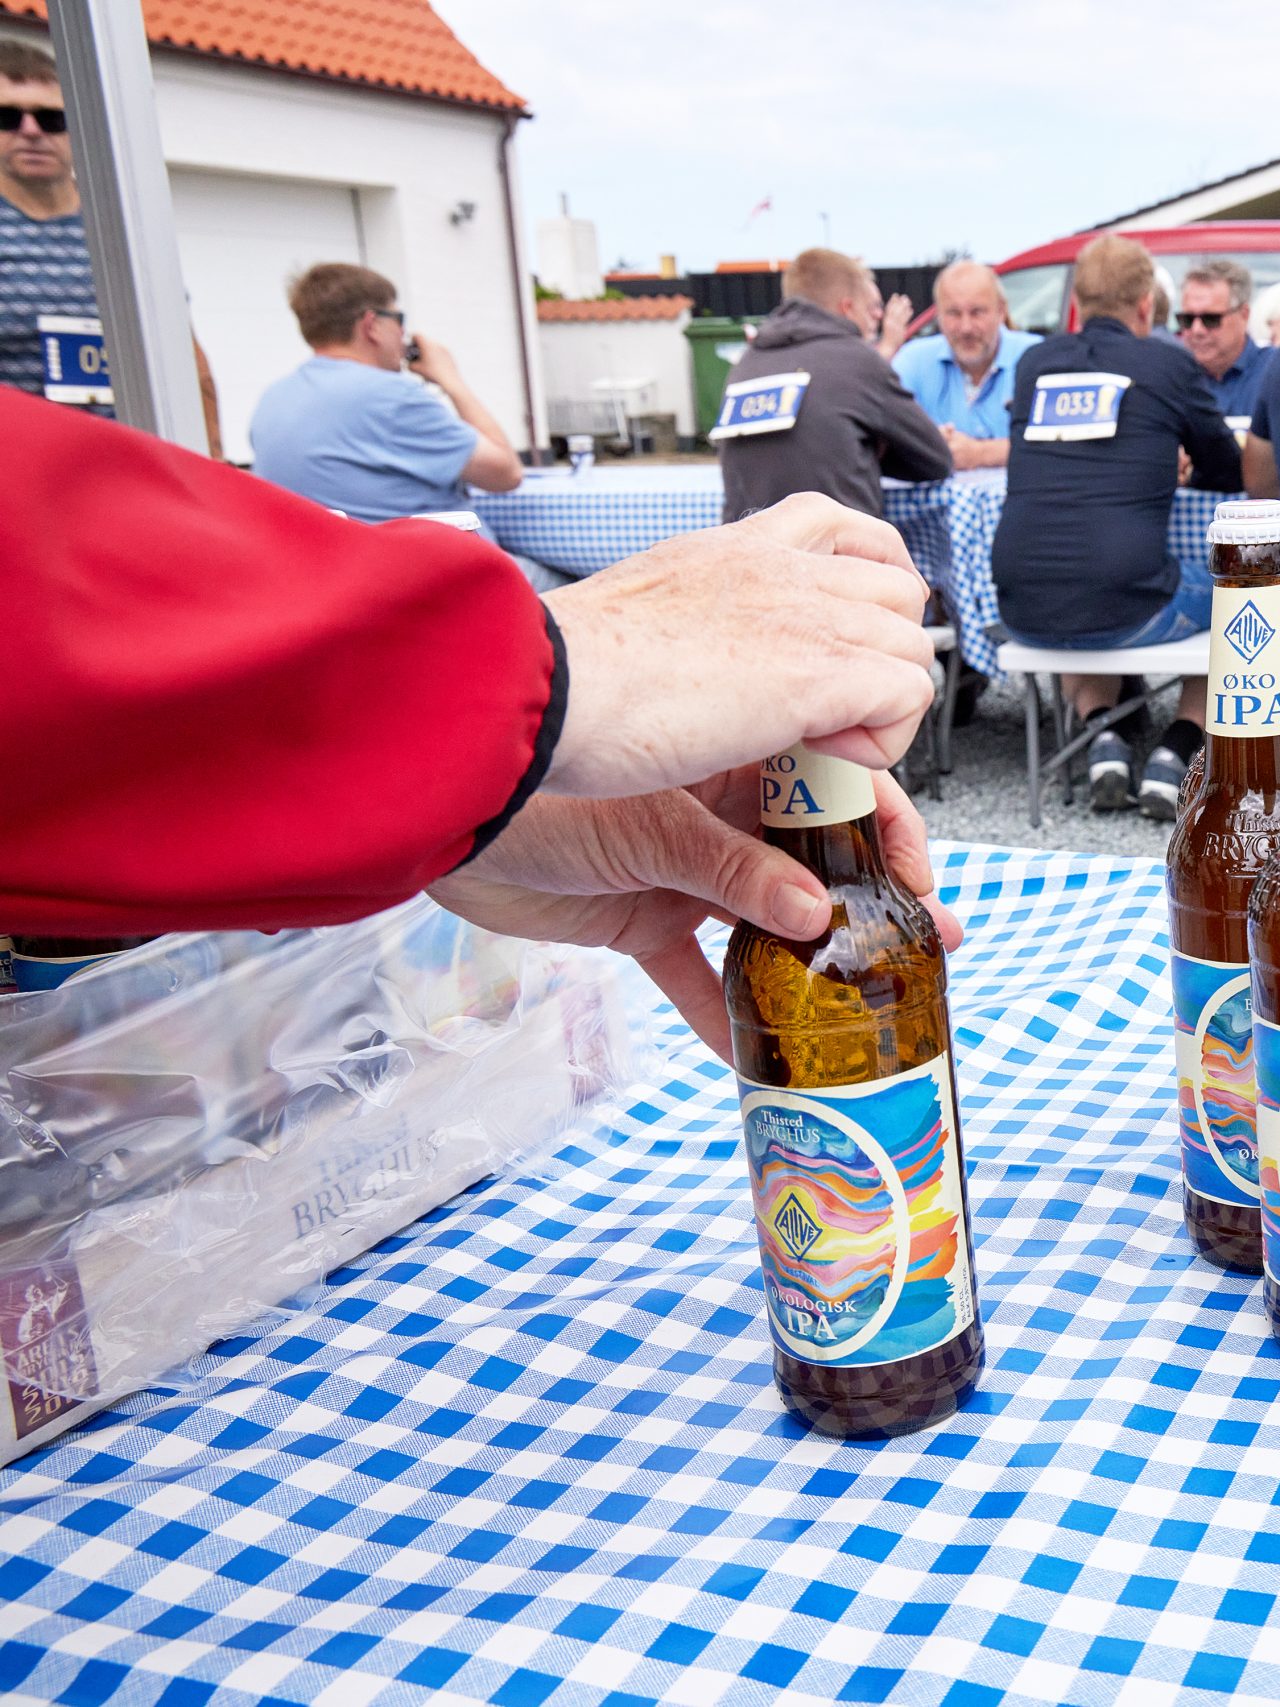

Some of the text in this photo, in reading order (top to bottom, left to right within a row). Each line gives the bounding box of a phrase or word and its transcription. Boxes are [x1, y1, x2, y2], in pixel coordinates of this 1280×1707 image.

[1056, 391, 1096, 417] 033
[1223, 672, 1276, 690] ØKO
[761, 1110, 804, 1128] Thisted
[756, 1121, 821, 1144] BRYGHUS
[771, 1286, 858, 1314] ØKOLOGISK
[784, 1305, 838, 1341] IPA
